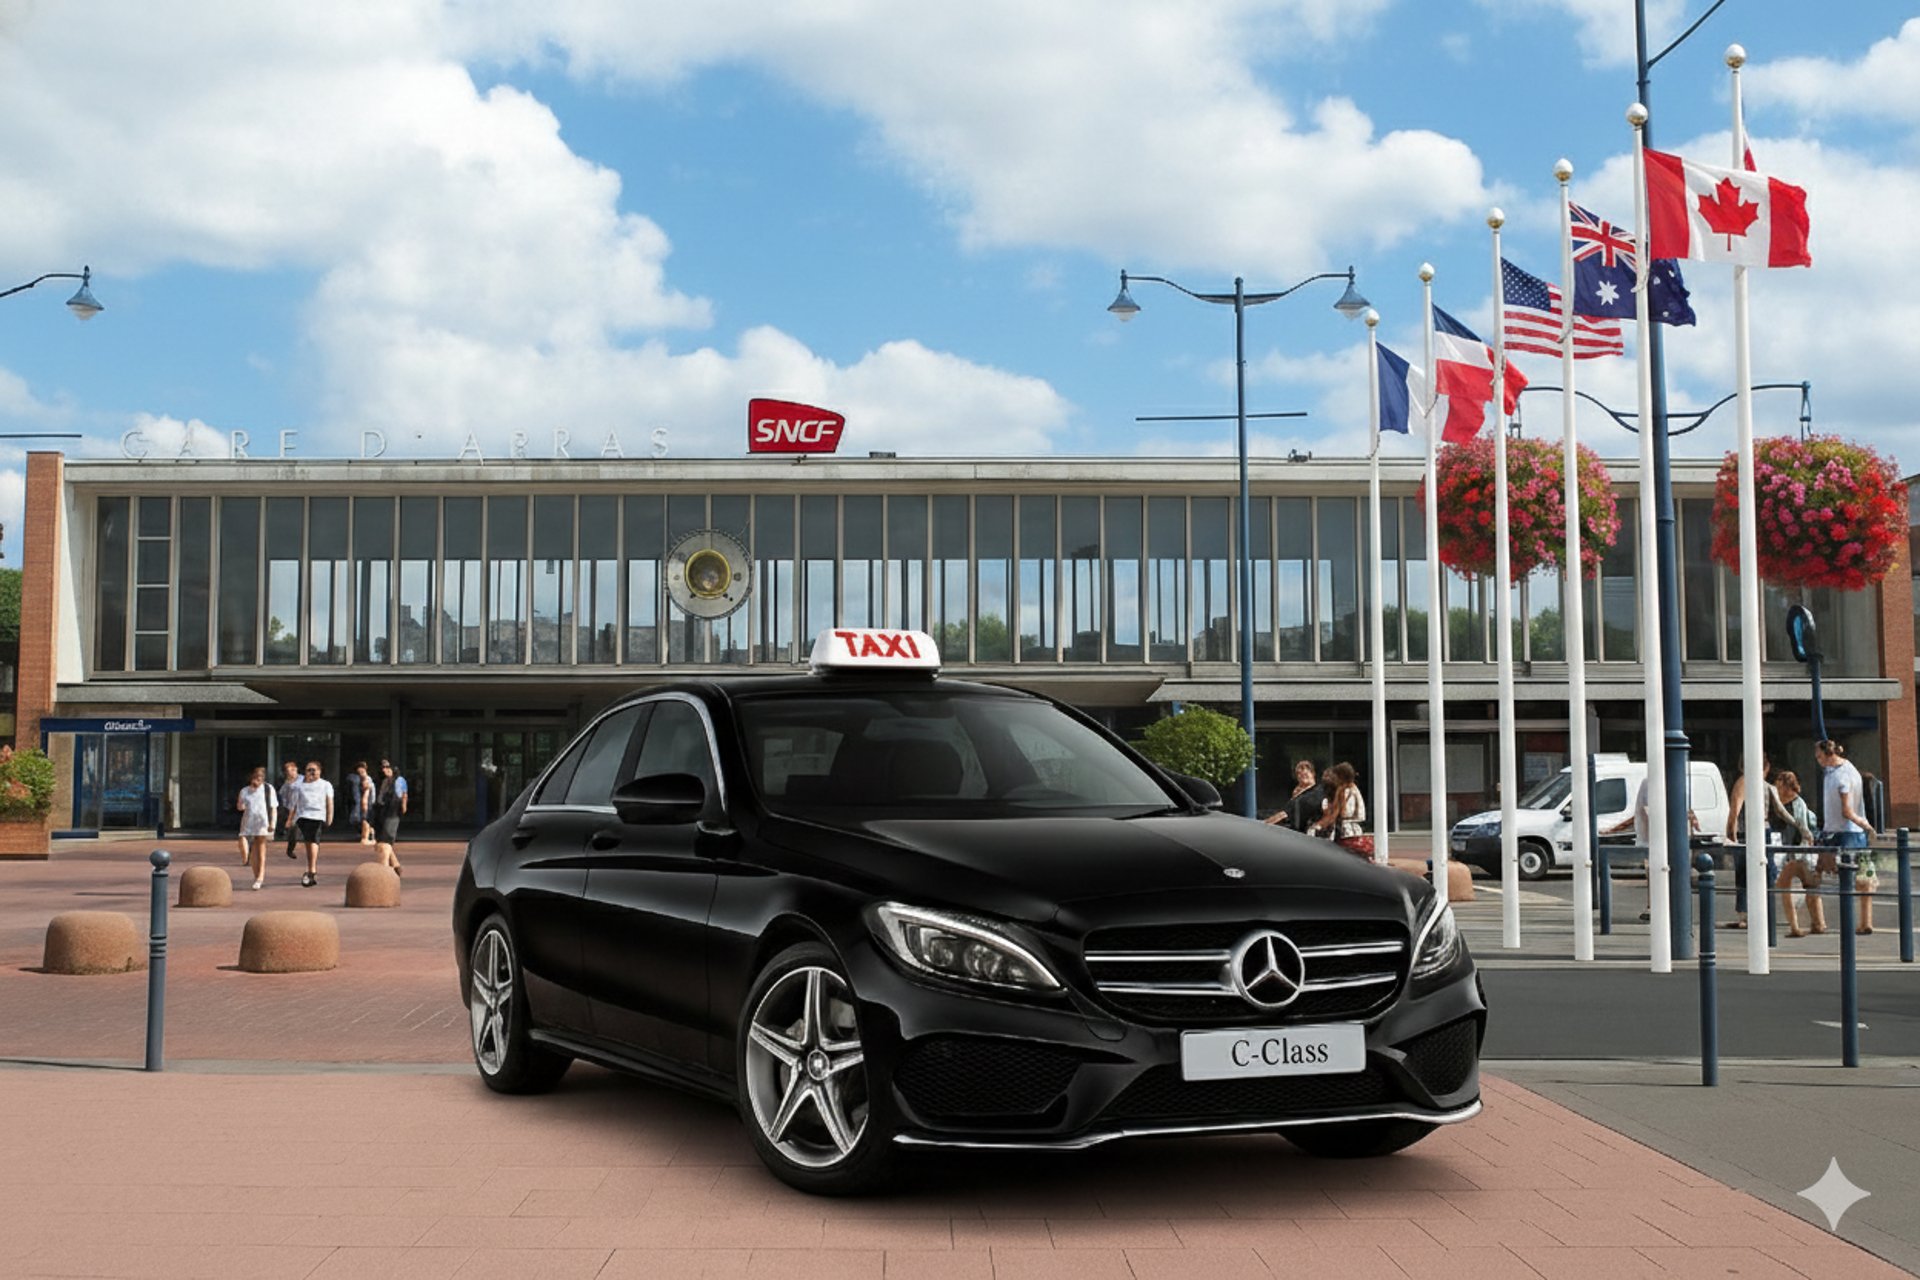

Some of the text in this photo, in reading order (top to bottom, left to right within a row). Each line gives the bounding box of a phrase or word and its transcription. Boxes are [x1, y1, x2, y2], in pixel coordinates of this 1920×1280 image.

[755, 418, 837, 443] SNCF
[834, 631, 921, 659] TAXI
[1231, 1037, 1329, 1067] C-Class
